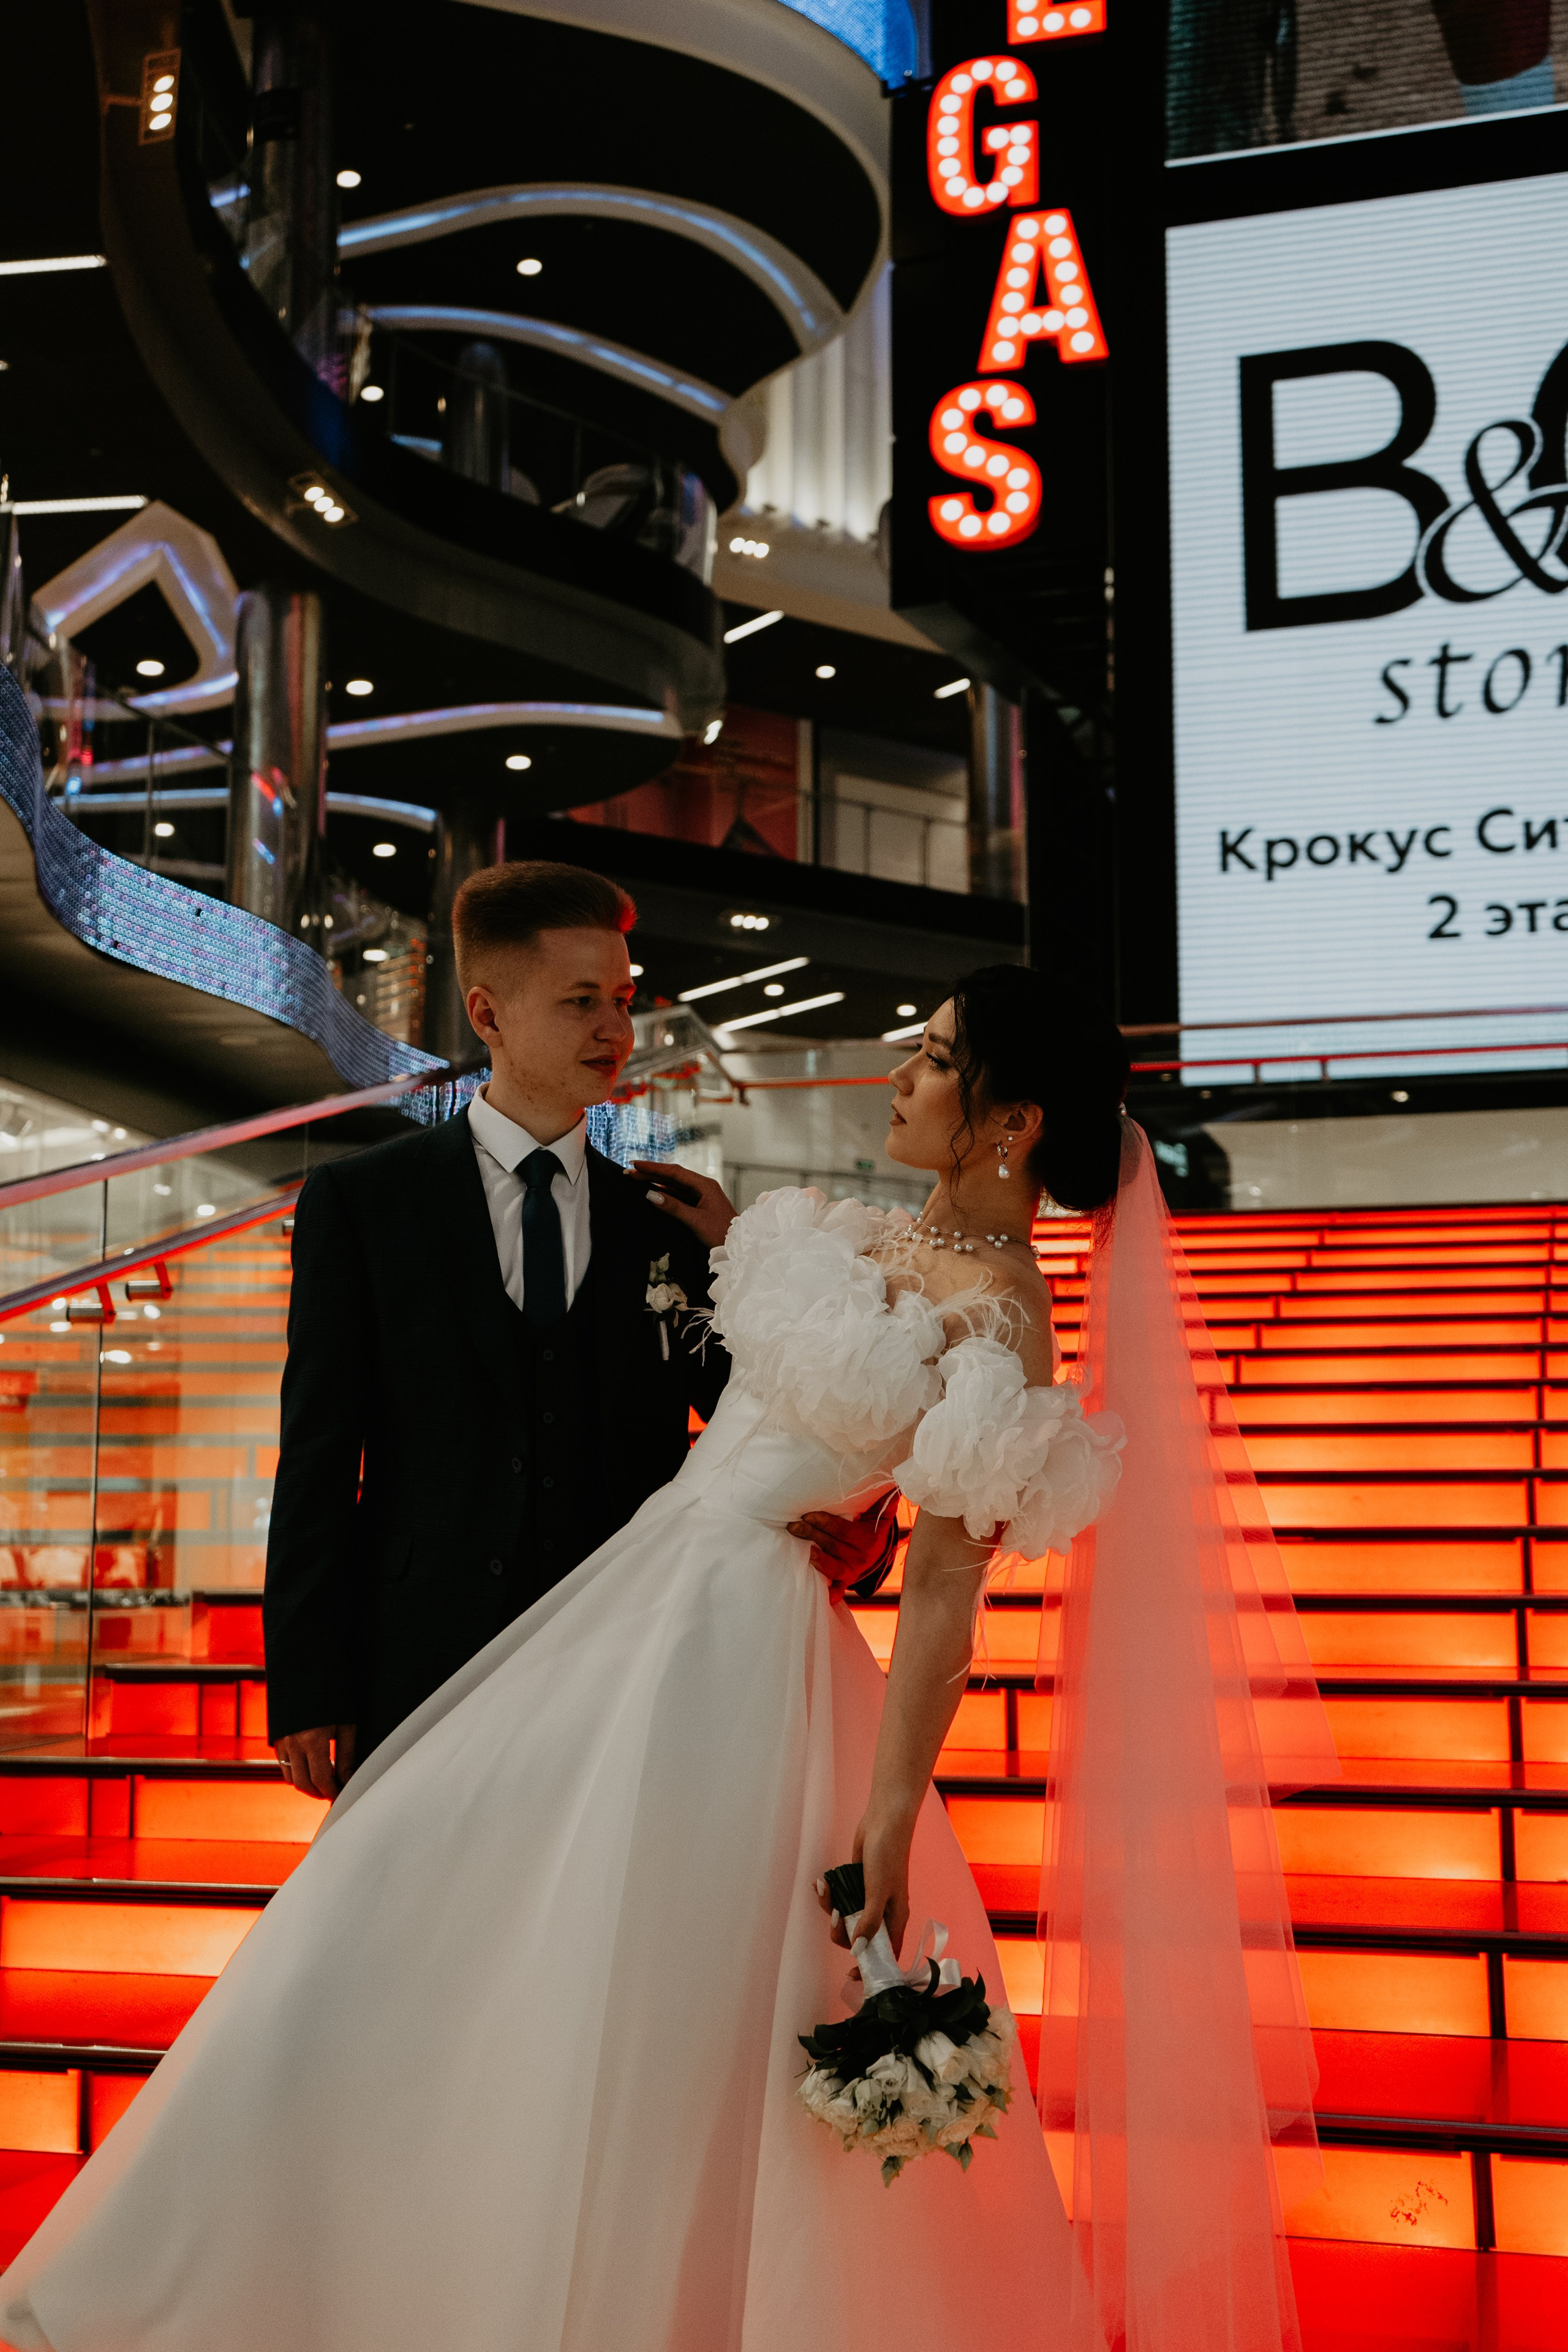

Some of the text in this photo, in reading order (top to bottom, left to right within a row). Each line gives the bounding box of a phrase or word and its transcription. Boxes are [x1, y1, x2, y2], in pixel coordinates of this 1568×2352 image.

[1238, 339, 1568, 633] B&
[1220, 807, 1568, 881] Крокус Си
[1428, 894, 1461, 939] 2
